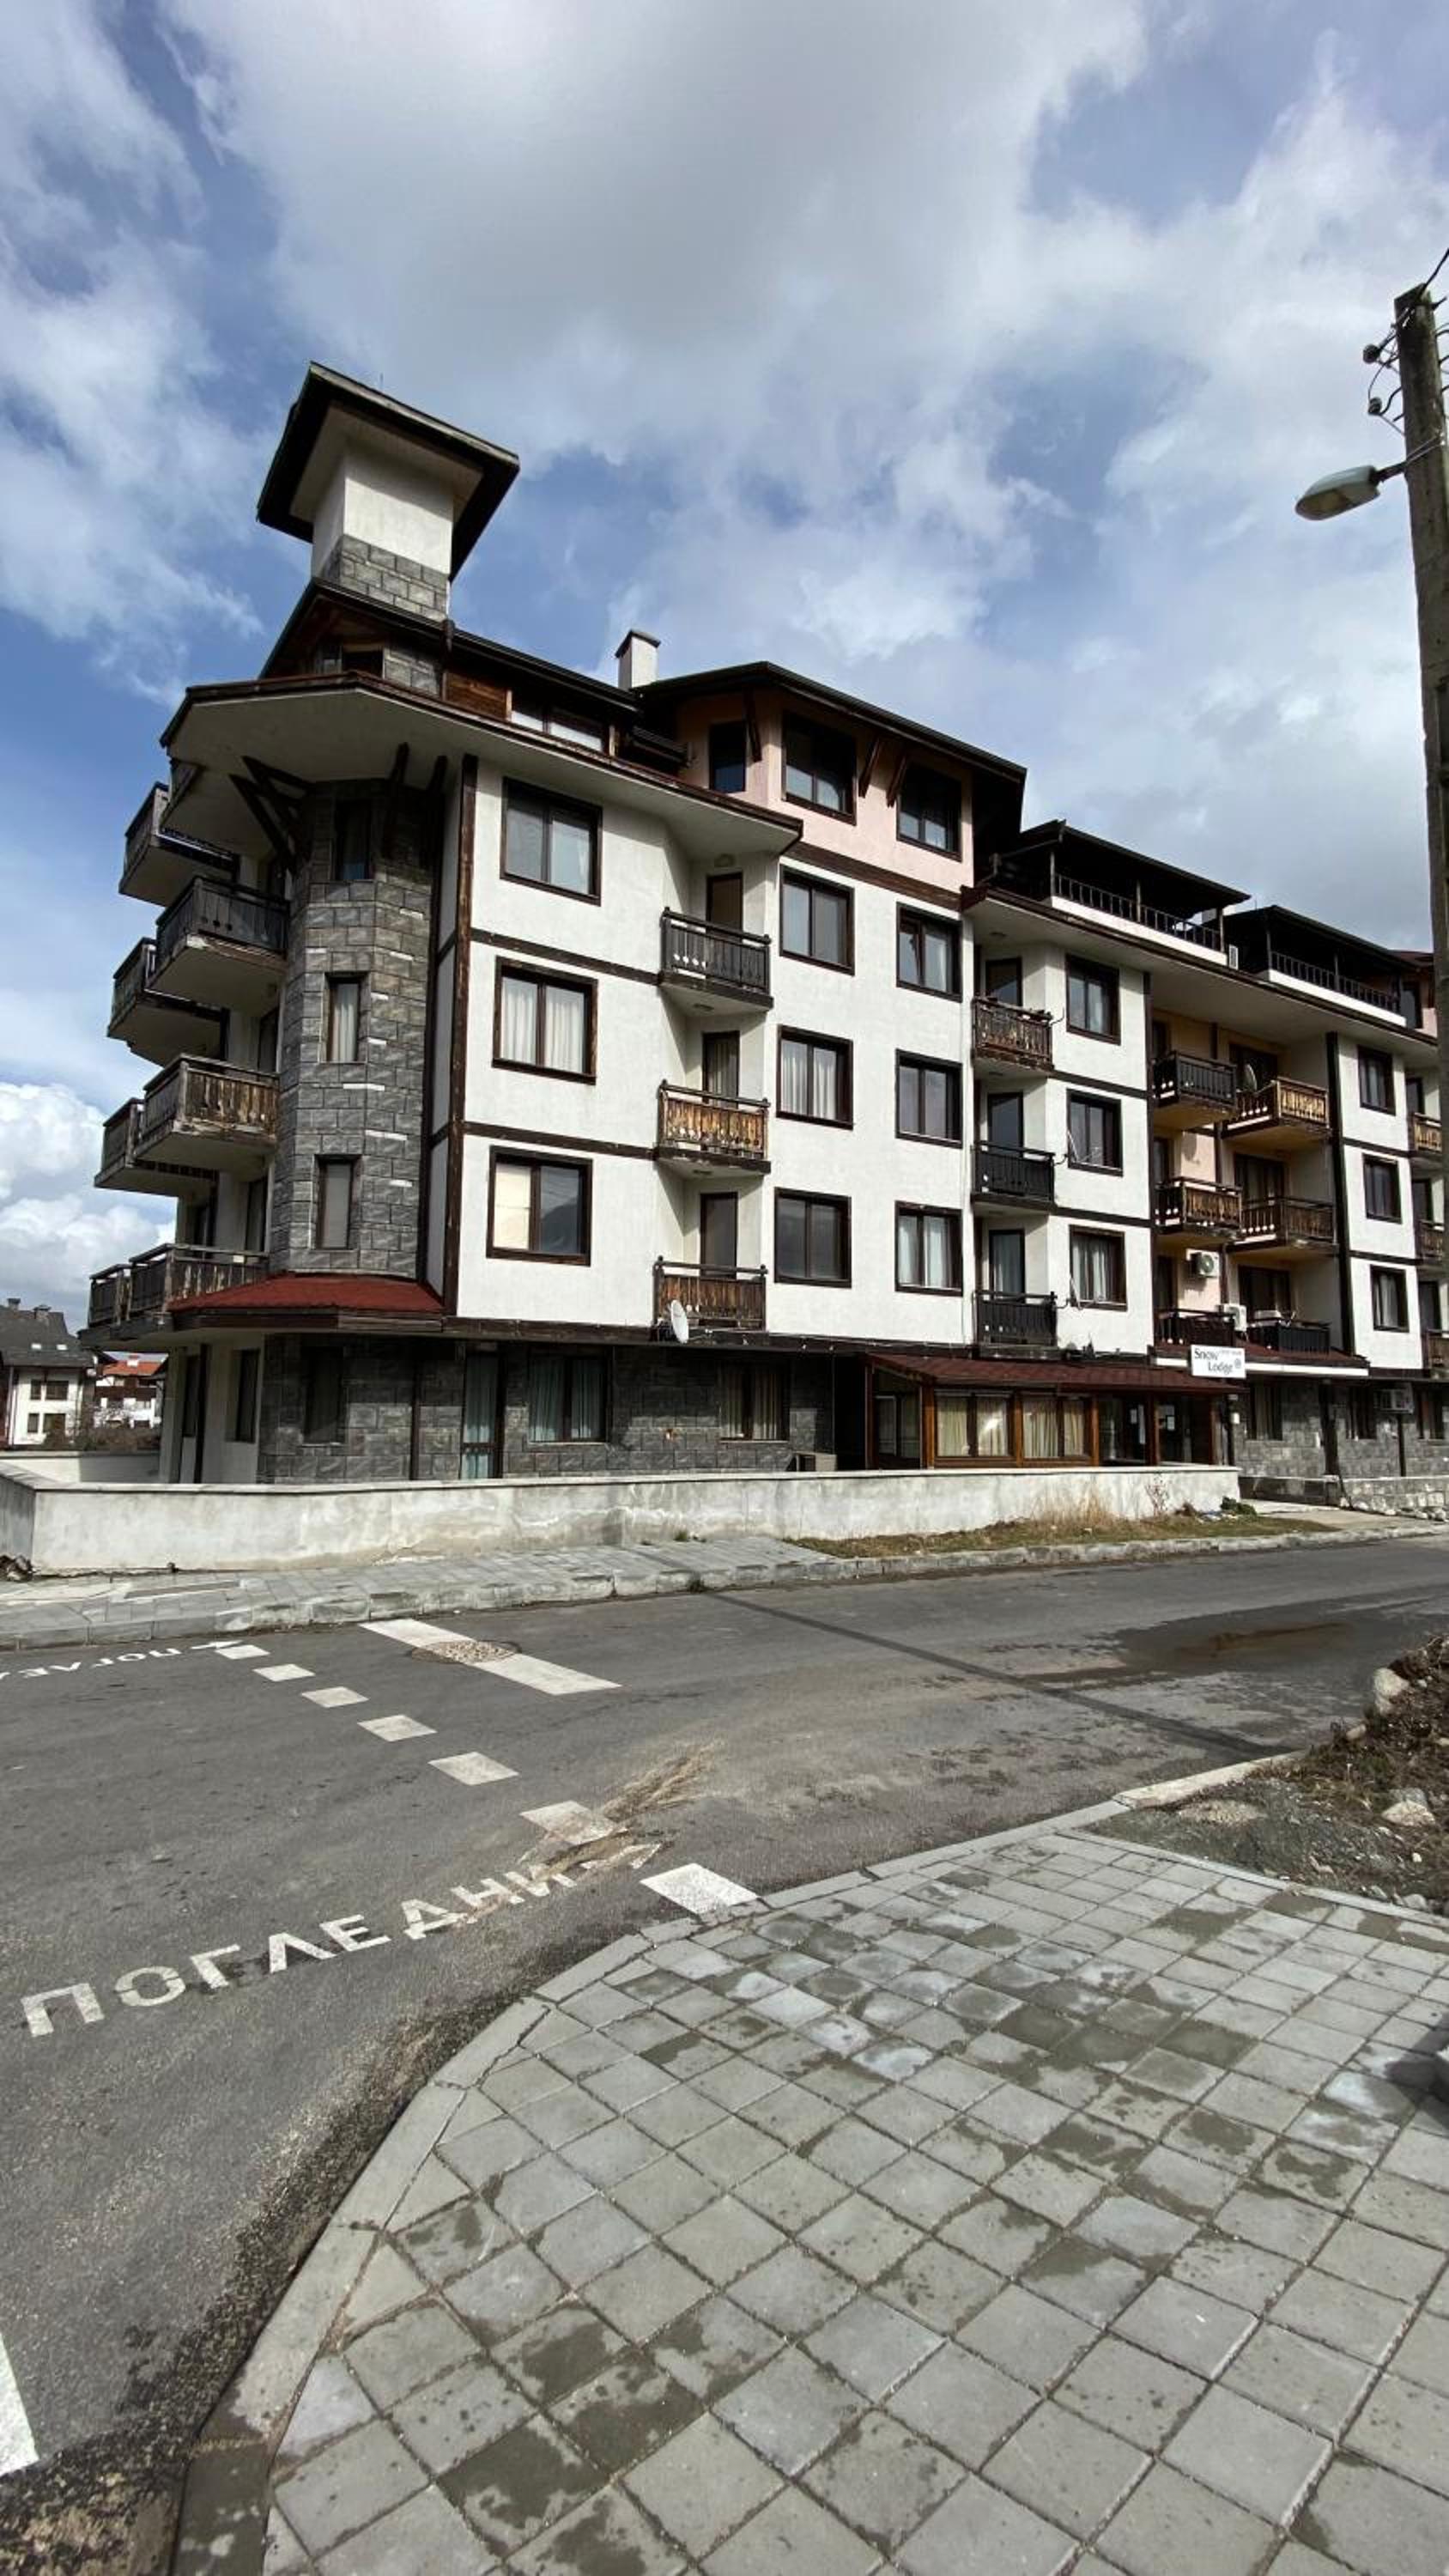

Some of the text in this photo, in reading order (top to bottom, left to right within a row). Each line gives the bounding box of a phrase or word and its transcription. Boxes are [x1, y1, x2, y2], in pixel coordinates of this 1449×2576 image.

[1194, 1347, 1218, 1360] Snow
[1208, 1361, 1233, 1376] Lodge
[21, 1863, 579, 2038] ПОГЛЕДНИ
